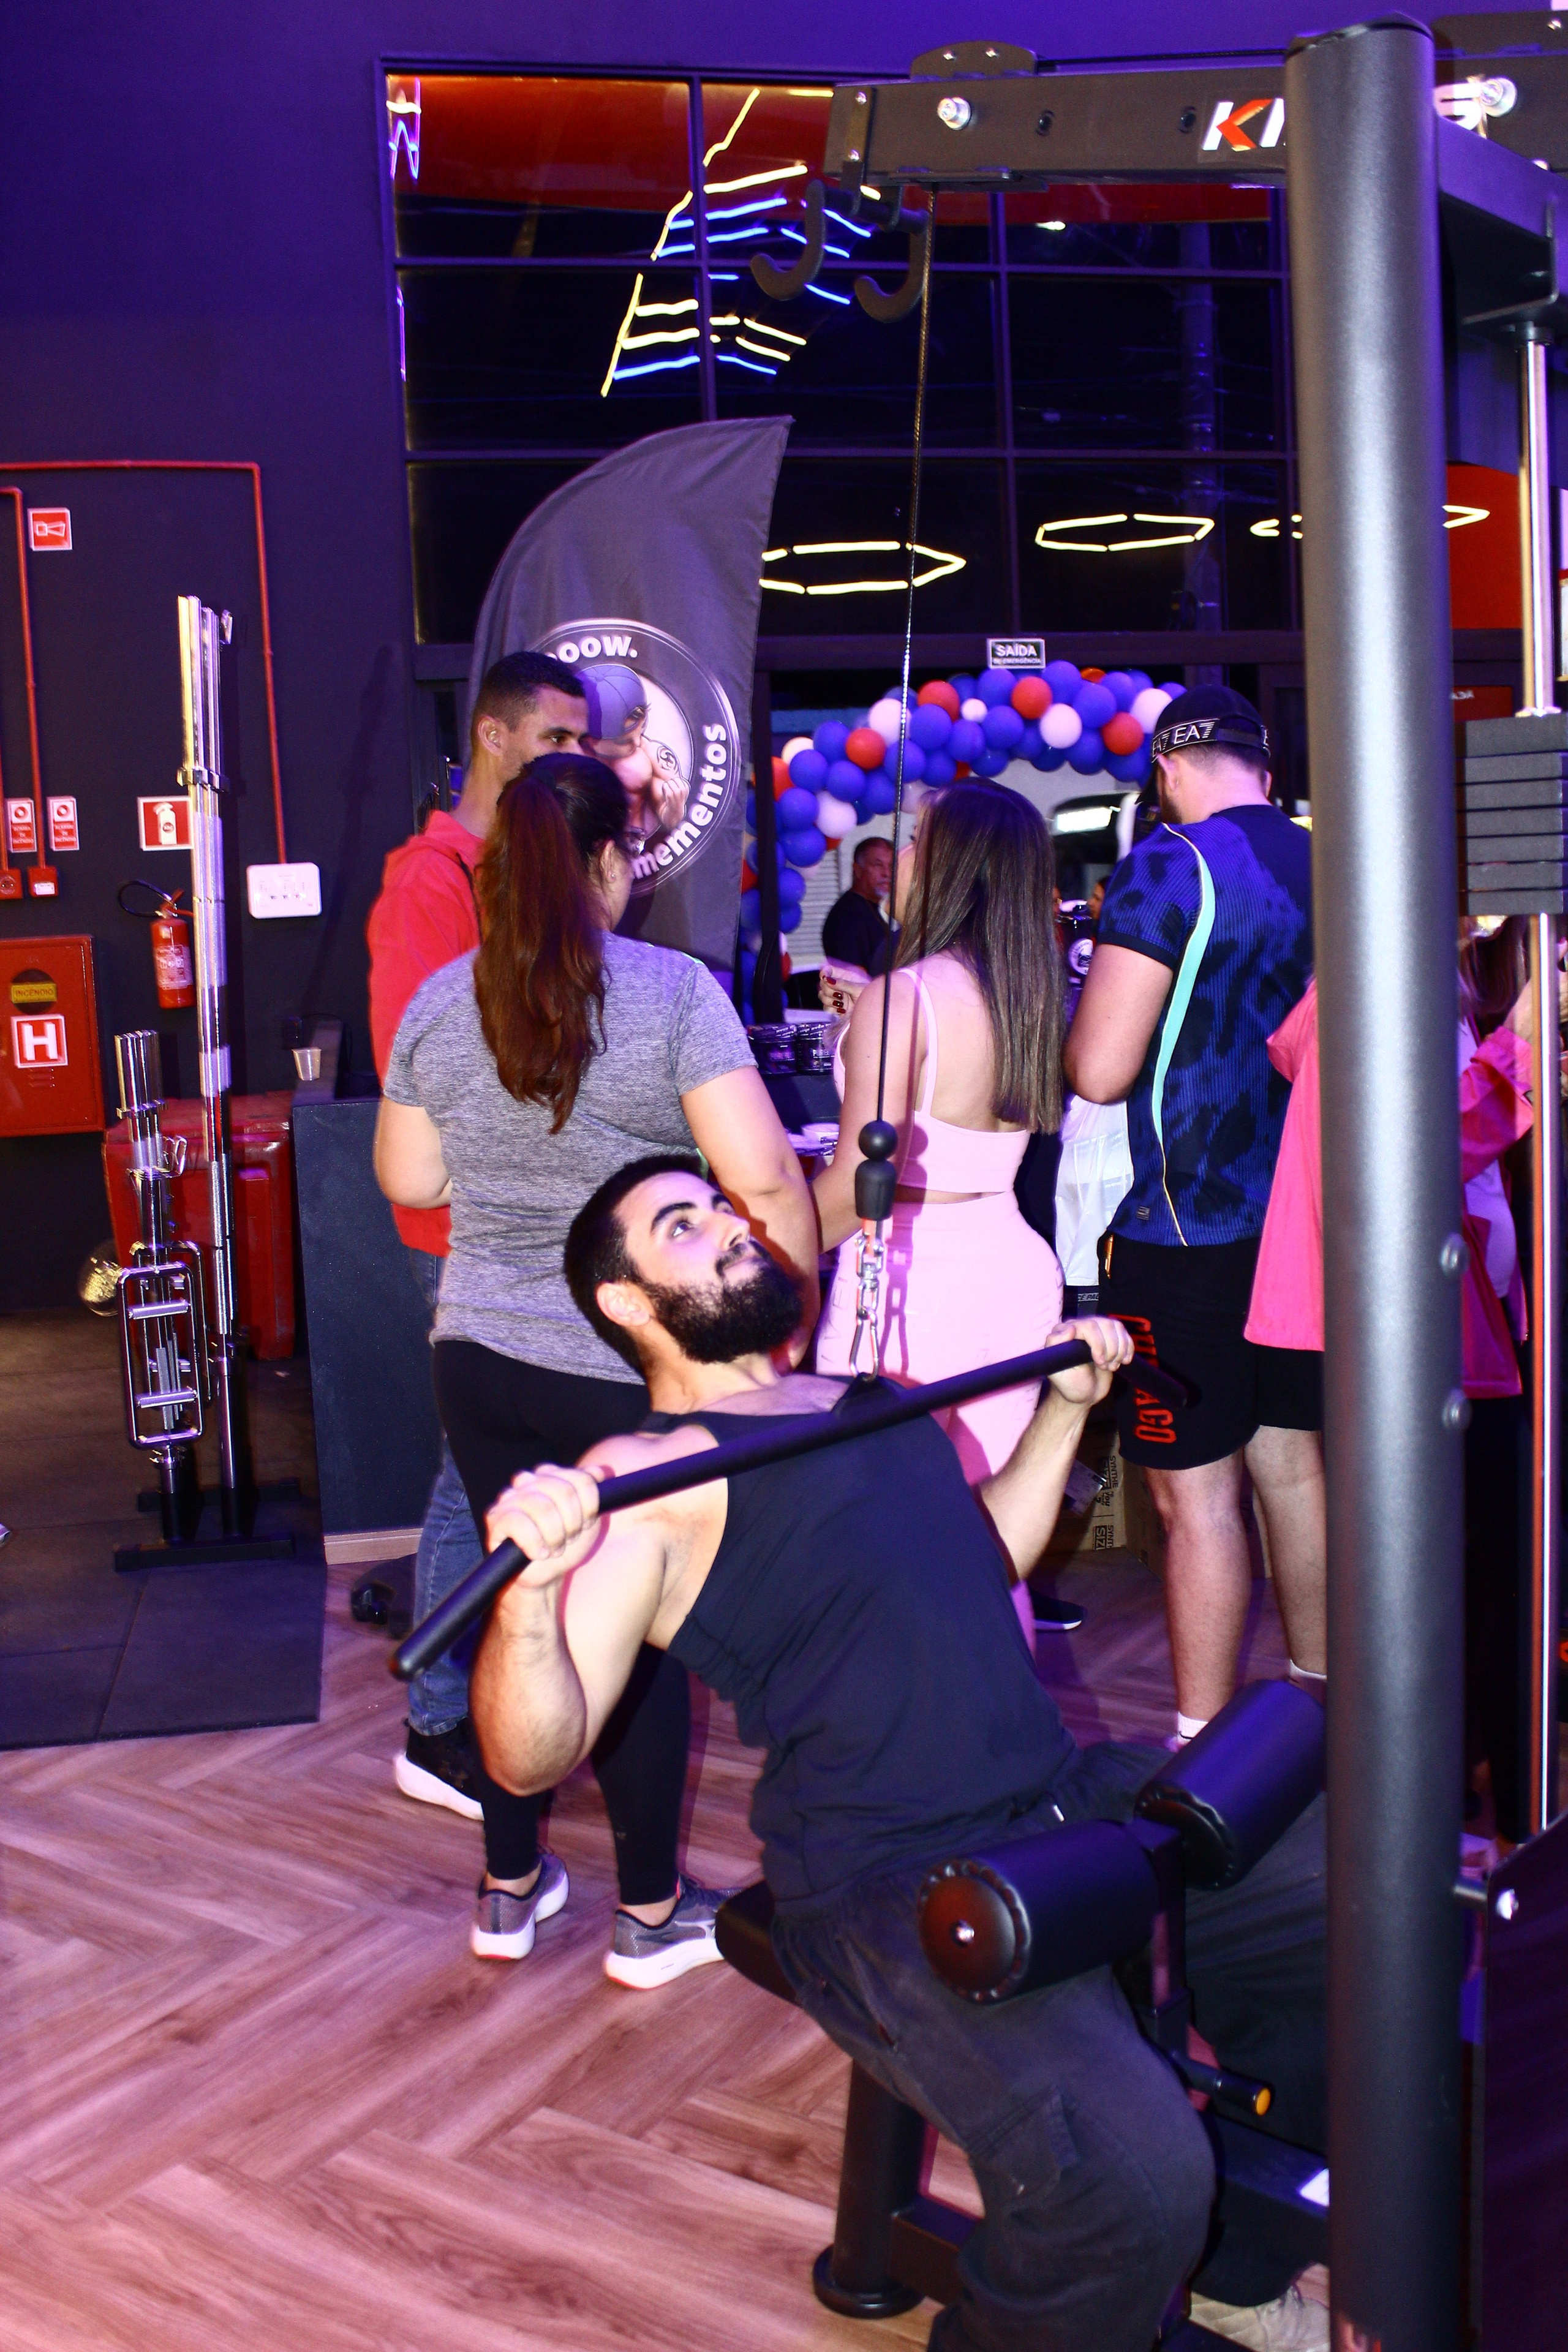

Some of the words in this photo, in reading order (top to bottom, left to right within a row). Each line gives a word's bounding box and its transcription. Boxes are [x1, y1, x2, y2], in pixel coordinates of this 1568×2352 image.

[995, 641, 1037, 657] SAÍDA
[1174, 722, 1215, 745] EA7
[21, 1022, 58, 1061] H
[1107, 1313, 1177, 1444] CHAGO
